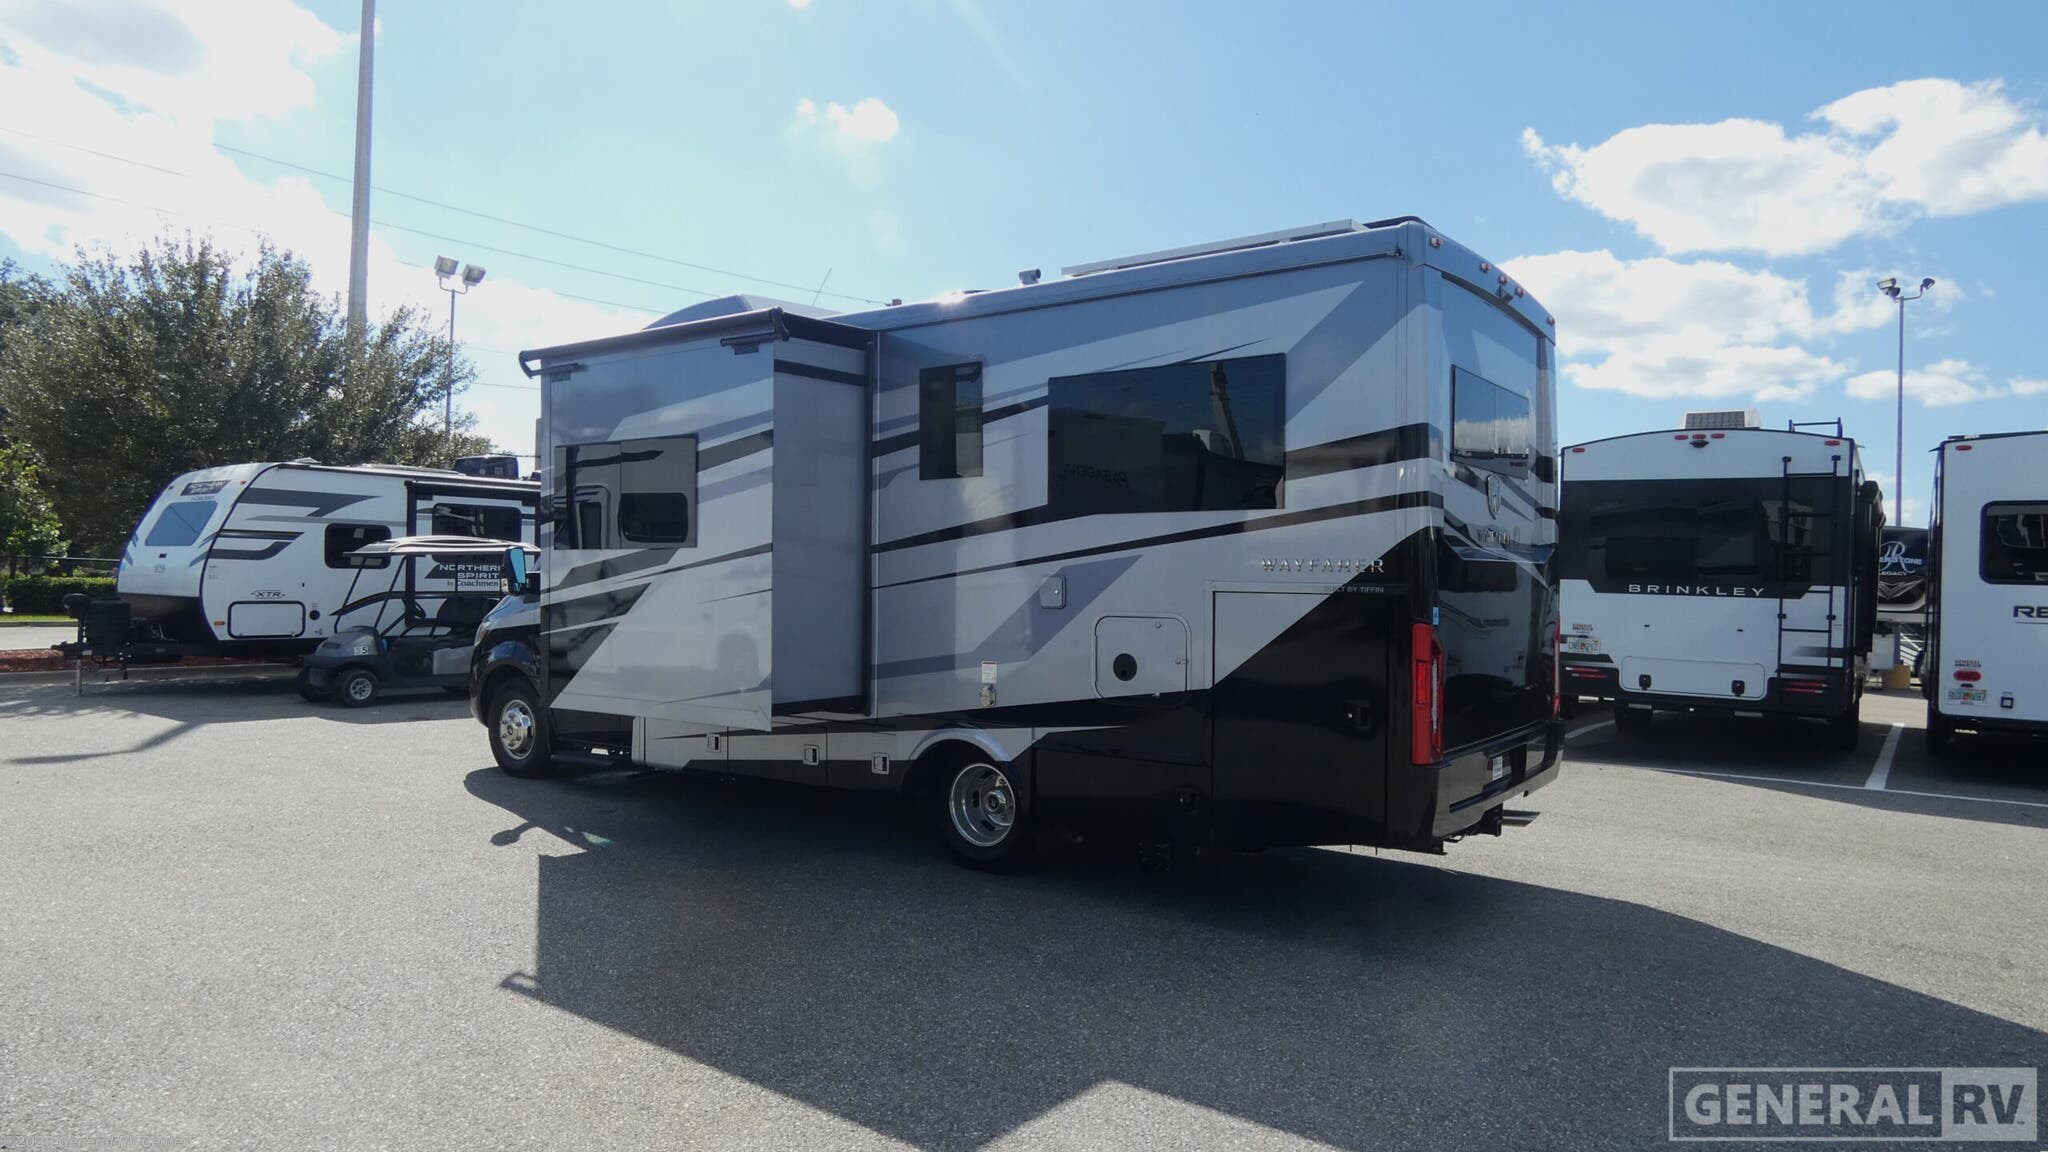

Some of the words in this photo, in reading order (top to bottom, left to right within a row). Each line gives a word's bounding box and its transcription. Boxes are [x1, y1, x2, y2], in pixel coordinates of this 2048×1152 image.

[1261, 558, 1384, 573] WAYFARER
[457, 579, 499, 587] Coachmen
[1628, 584, 1765, 597] BRINKLEY
